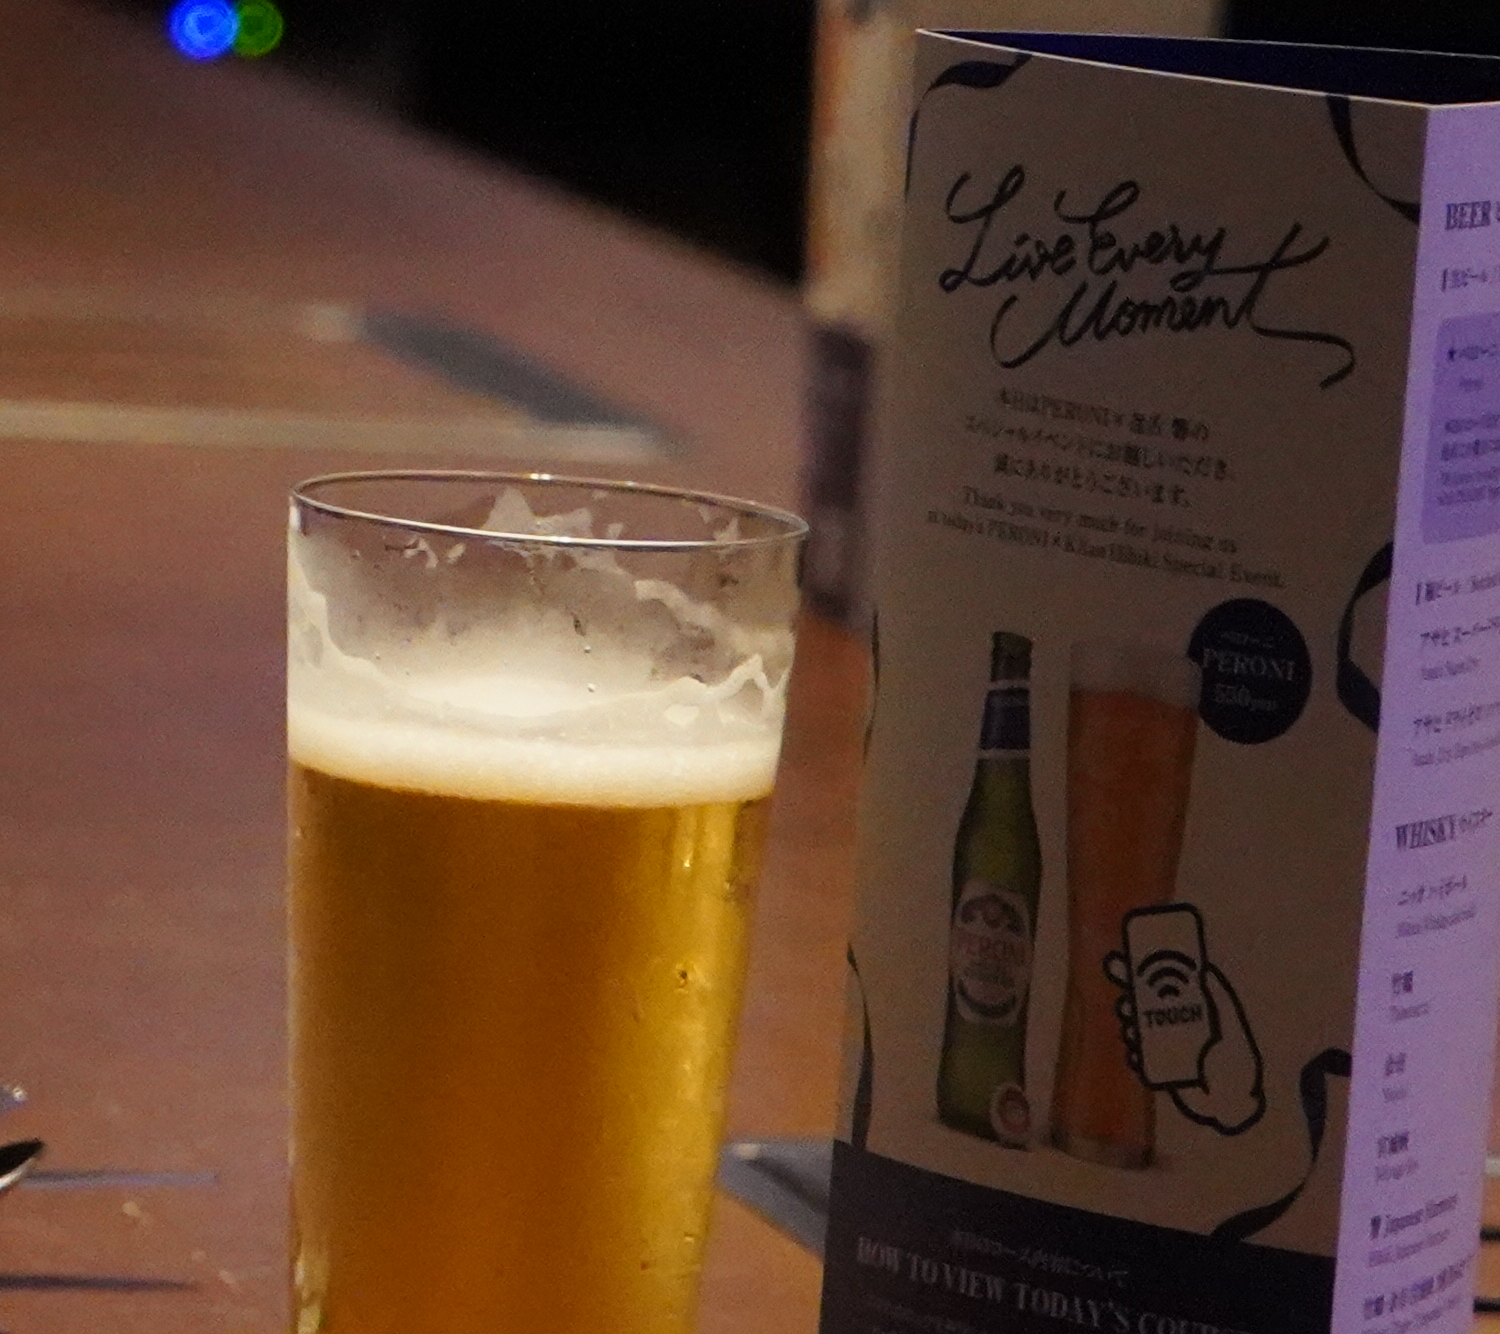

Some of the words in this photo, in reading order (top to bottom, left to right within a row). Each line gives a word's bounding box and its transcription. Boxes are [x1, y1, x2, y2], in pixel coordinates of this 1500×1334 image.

[940, 162, 1077, 294] Live
[1054, 179, 1228, 294] Every
[1444, 199, 1491, 233] BEER
[989, 224, 1358, 391] Moment
[1202, 646, 1296, 682] PERONI
[1142, 1004, 1203, 1028] TOUCH
[856, 1234, 900, 1274] HOW
[904, 1249, 940, 1285] TO
[941, 1260, 1006, 1304] VIEW
